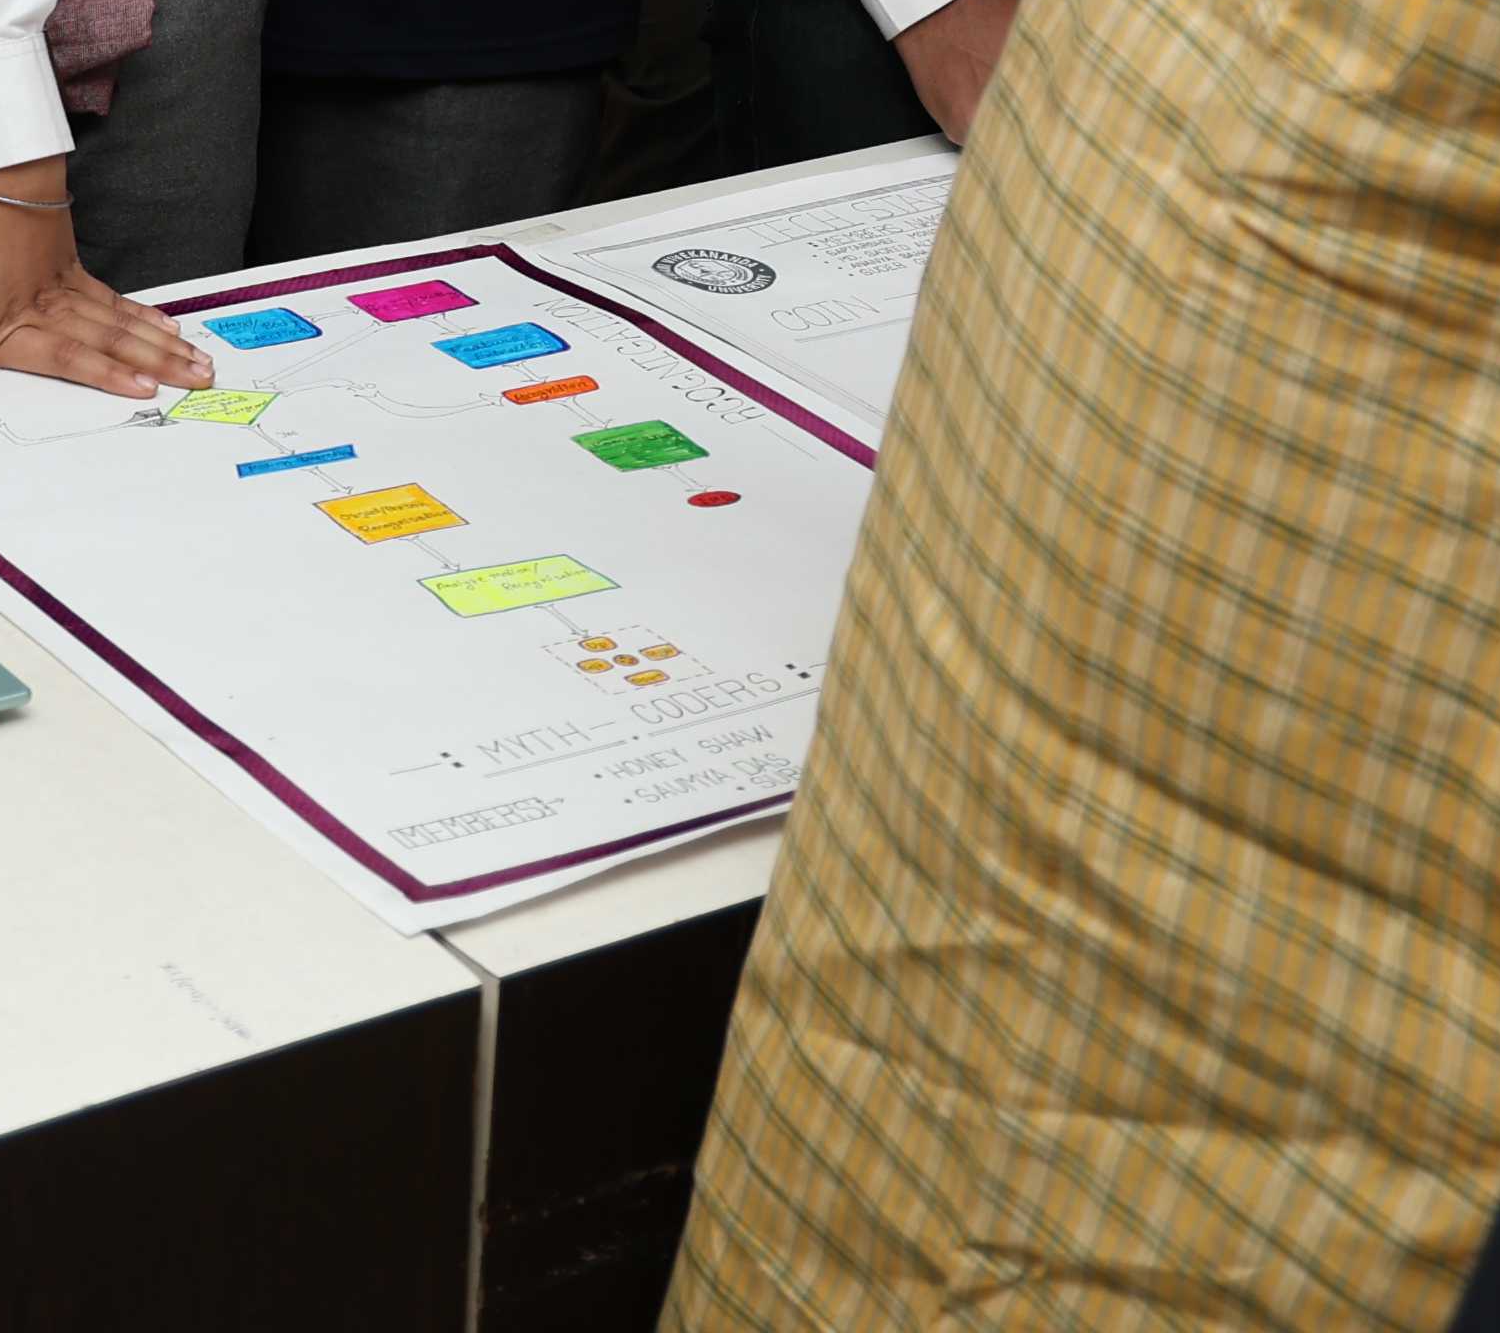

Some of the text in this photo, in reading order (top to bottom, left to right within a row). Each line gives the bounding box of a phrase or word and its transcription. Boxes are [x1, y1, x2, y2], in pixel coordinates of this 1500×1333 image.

[730, 208, 856, 247] TECH
[770, 295, 881, 332] COIN
[475, 671, 783, 766] MYTH CODERS
[604, 723, 775, 780] HONEY SHAW
[634, 752, 792, 805] SAUMYA DAS
